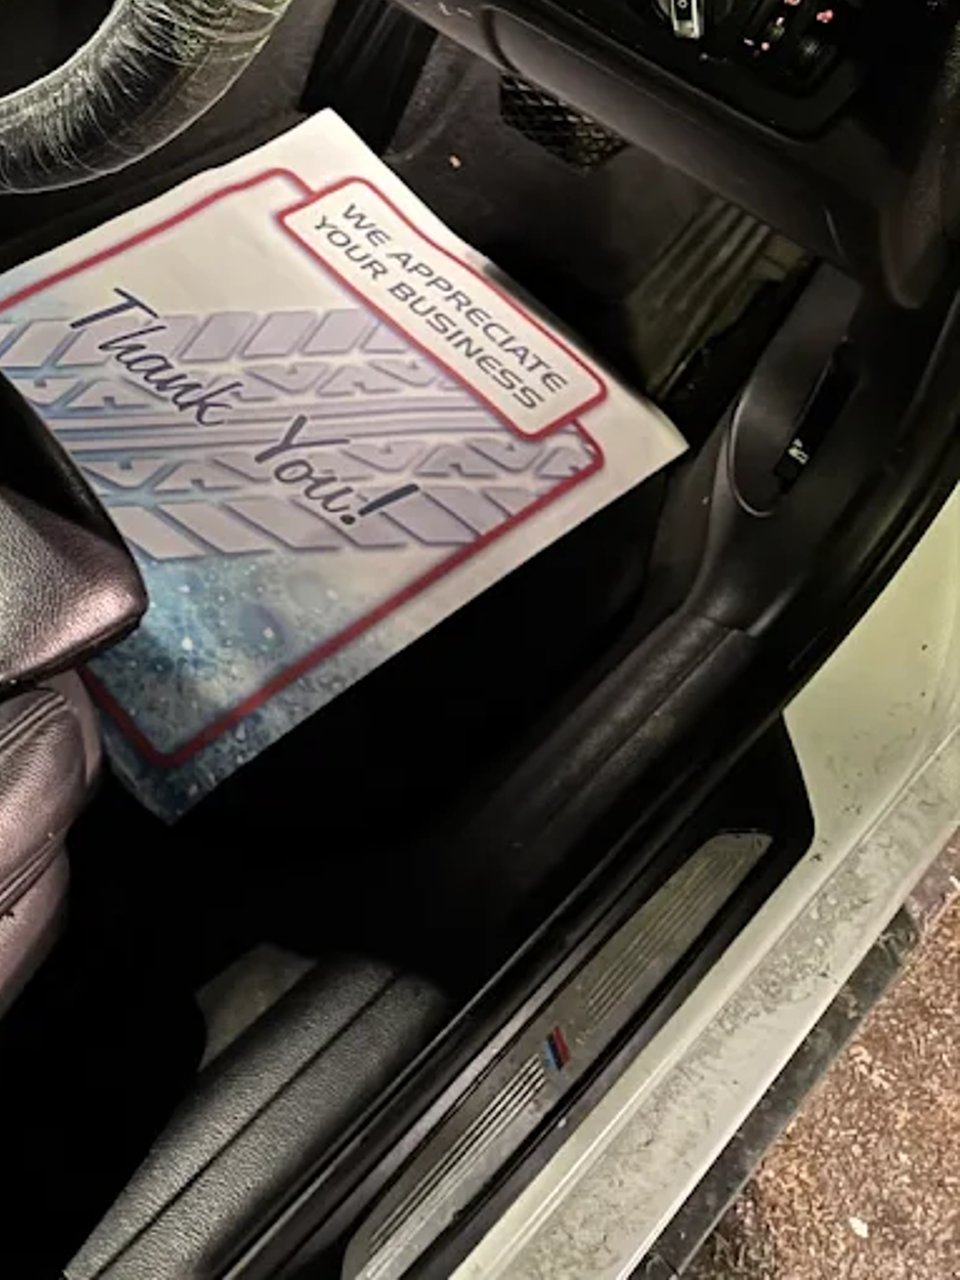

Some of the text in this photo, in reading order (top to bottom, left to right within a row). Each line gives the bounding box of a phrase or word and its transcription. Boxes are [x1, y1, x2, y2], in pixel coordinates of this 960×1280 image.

[314, 215, 545, 410] YOUR BUSINESS
[342, 203, 569, 393] WE APPRECIATE
[70, 287, 421, 526] Thank You!
